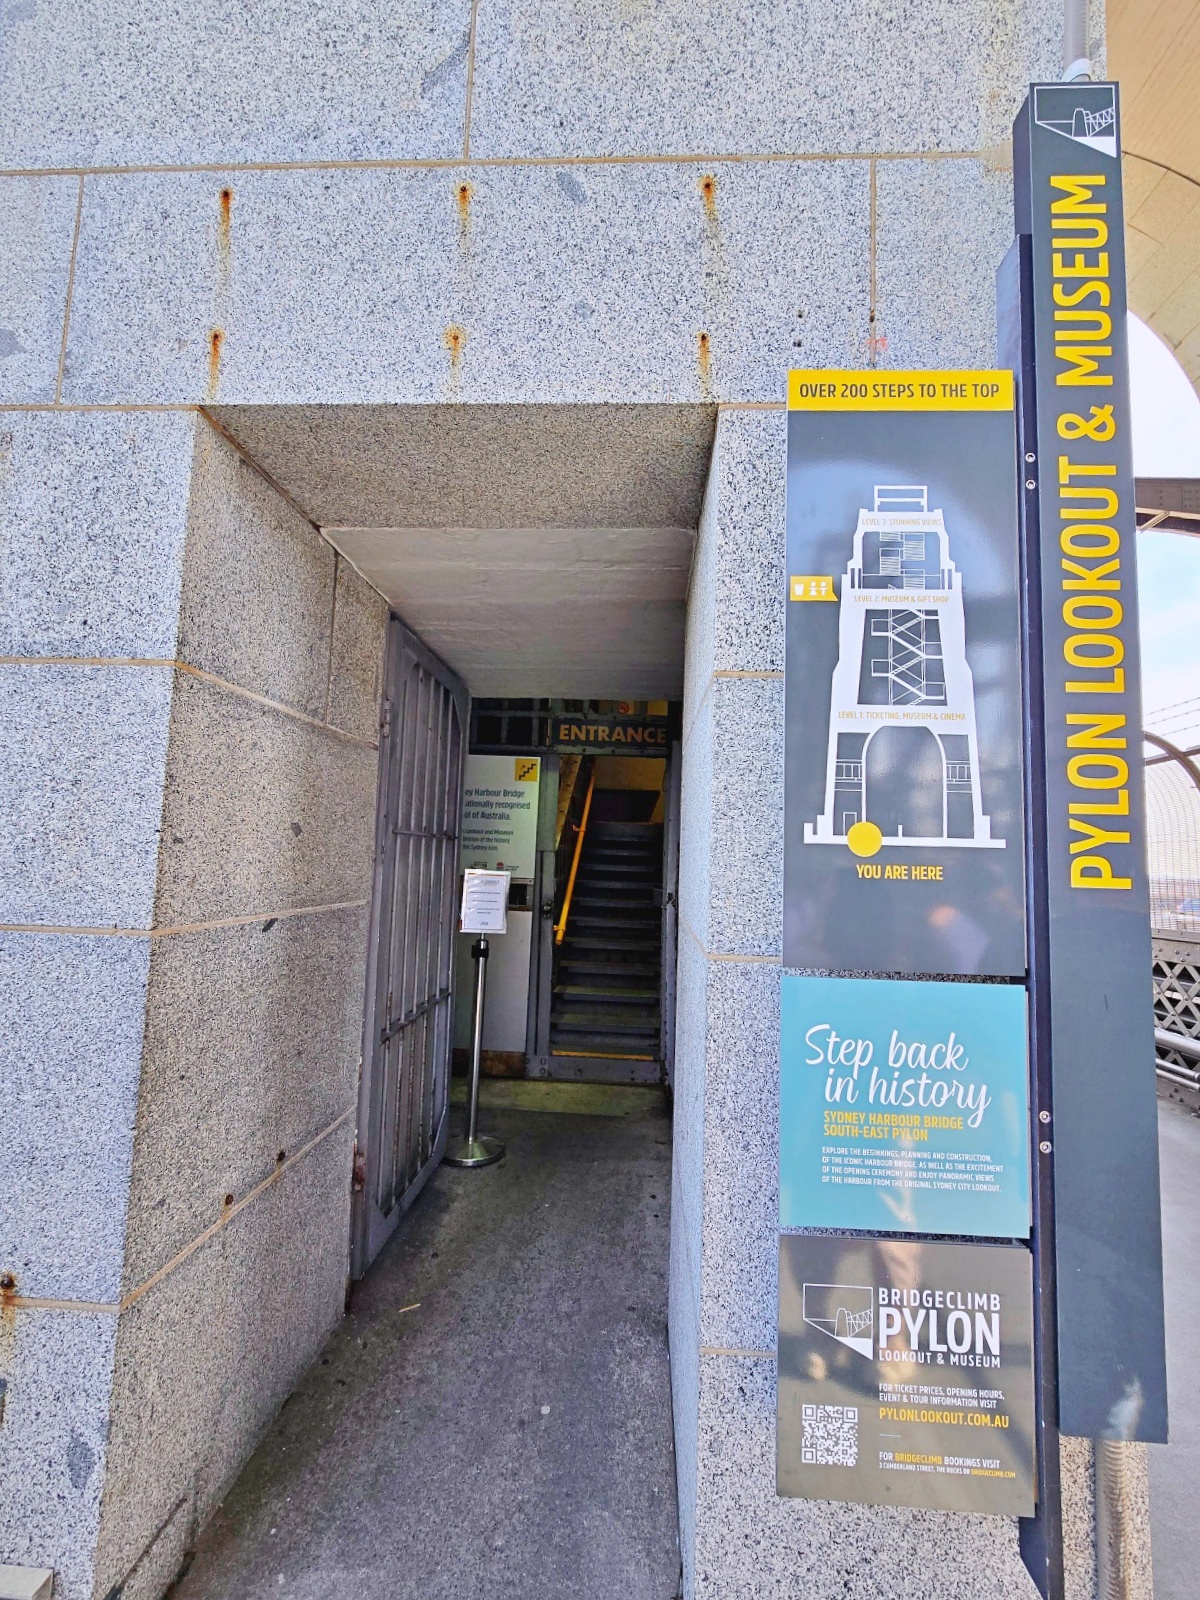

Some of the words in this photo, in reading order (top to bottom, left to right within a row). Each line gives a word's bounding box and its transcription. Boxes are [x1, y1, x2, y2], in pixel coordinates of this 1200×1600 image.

[1049, 174, 1113, 387] MUSEUM
[800, 383, 837, 398] OVER
[840, 383, 868, 398] 200
[872, 383, 915, 398] STEPS
[919, 383, 937, 398] TO
[941, 383, 968, 398] THE
[972, 383, 1000, 398] TOP
[1056, 404, 1117, 442] &
[862, 518, 881, 526] LEVEL
[889, 518, 921, 526] STUNNING
[922, 518, 942, 526] VIEWS
[1058, 455, 1125, 694] LOOKOUT
[854, 595, 873, 603] LEVEL
[881, 595, 911, 603] MUSEUM
[911, 595, 916, 603] &
[917, 595, 931, 603] GIFT
[932, 595, 949, 603] SHOP
[838, 711, 857, 719] LEVEL
[902, 712, 932, 720] MUSEUM
[940, 713, 966, 721] CINEMA
[560, 724, 667, 743] ENTRANCE
[474, 788, 502, 797] Harbour
[502, 789, 526, 799] Bridge
[1066, 713, 1132, 889] PYLON
[495, 801, 531, 810] recognised
[472, 811, 480, 819] of
[480, 811, 512, 821] Australia.
[856, 864, 882, 879] YOU
[884, 864, 909, 880] ARE
[911, 865, 944, 881] HERE
[804, 1023, 875, 1080] Step
[888, 1029, 970, 1072] back
[824, 1068, 860, 1104] in
[868, 1066, 992, 1128] history
[823, 1110, 866, 1125] SYDNEY
[868, 1112, 921, 1128] HARBOUR
[924, 1115, 964, 1130] BRIDGE
[823, 1123, 889, 1139] SOUTH-EAST
[892, 1127, 929, 1141] PYLON
[822, 1146, 849, 1155] EXPLORE
[850, 1147, 861, 1156] THE
[862, 1148, 900, 1158] BEGINNINGS,
[901, 1150, 931, 1159] PLANNING
[932, 1152, 945, 1160] AND
[822, 1156, 830, 1164] OF
[831, 1156, 843, 1165] THE
[843, 1157, 863, 1166] ICONIC
[864, 1158, 893, 1167] HARBOUR
[919, 1161, 927, 1169] AS
[928, 1162, 944, 1170] WELL
[945, 1162, 953, 1170] AS
[954, 1163, 966, 1171] THE
[966, 1163, 1004, 1173] EXCITEMENT
[831, 1166, 843, 1174] THE
[843, 1167, 870, 1176] OPENING
[871, 1168, 904, 1178] CEREMONY
[904, 1170, 917, 1178] AND
[918, 1171, 937, 1179] ENJOY
[938, 1172, 974, 1181] PANORAMIC
[975, 1174, 995, 1182] VIEWS
[821, 1175, 830, 1183] OF
[831, 1176, 843, 1184] THE
[843, 1177, 873, 1186] HARBOUR
[873, 1178, 891, 1186] FROM
[892, 1179, 903, 1188] THE
[904, 1180, 932, 1189] ORIGINAL
[933, 1181, 957, 1190] SYDNEY
[957, 1182, 971, 1191] CITY
[971, 1183, 1002, 1192] LOOKOUT.
[879, 1287, 1001, 1311] BRIDGECLIMB
[879, 1306, 1000, 1356] PYLON
[879, 1350, 932, 1365] LOOKOUT
[936, 1353, 945, 1365] &
[950, 1354, 1001, 1369] MUSEUM
[878, 1382, 893, 1392] FOR
[894, 1383, 918, 1394] TICKET
[919, 1385, 945, 1397] PRICES,
[946, 1387, 978, 1398] OPENING
[979, 1389, 1005, 1400] HOURS,
[879, 1392, 901, 1402] EVENT
[902, 1394, 908, 1403] &
[910, 1394, 929, 1405] TOUR
[930, 1396, 978, 1408] INFORMATION
[980, 1399, 998, 1409] VISIT
[879, 1407, 1010, 1429] PYLONLOOKOUT.COM.AU
[879, 1451, 894, 1461] FOR
[894, 1452, 943, 1465] BRIDGECLIMB
[944, 1456, 981, 1468] BOOKINGS
[981, 1458, 1001, 1469] VISIT
[883, 1462, 916, 1471] CUMBERLAND
[946, 1467, 963, 1475] ROCKS
[971, 1468, 1016, 1479] BRIDGECLIMB.COM
